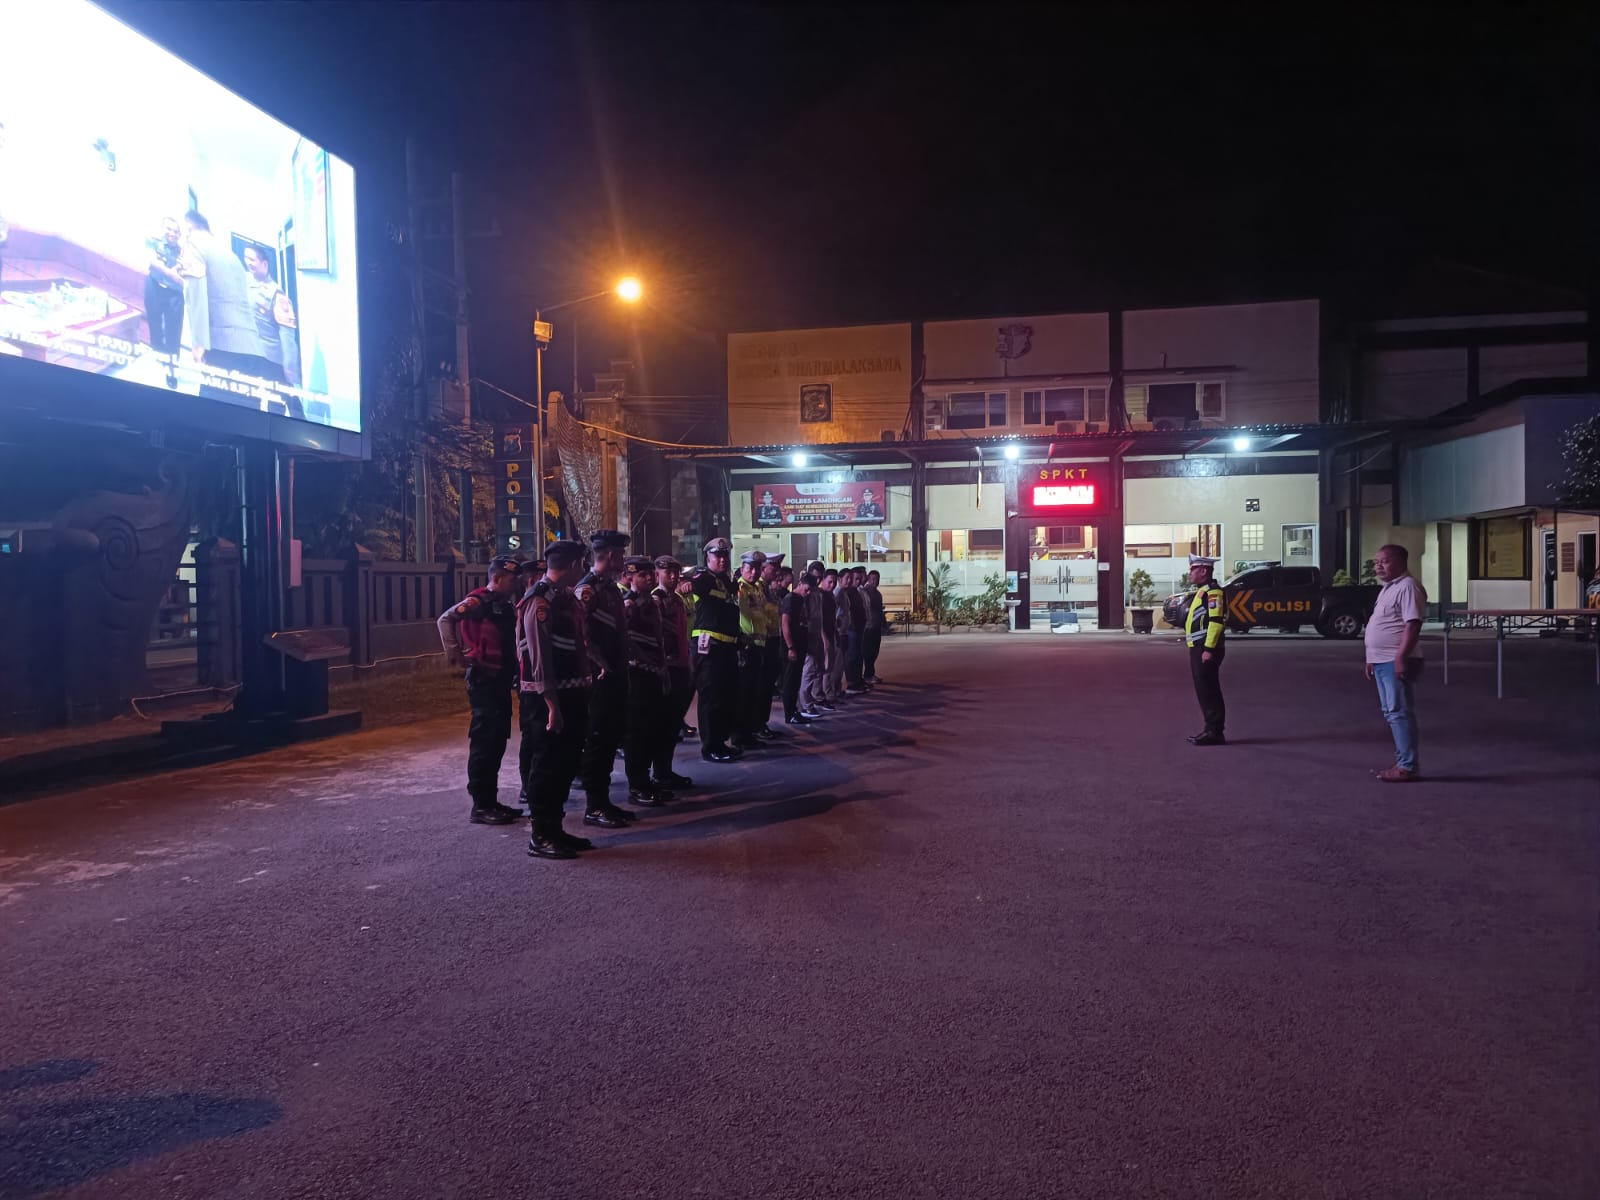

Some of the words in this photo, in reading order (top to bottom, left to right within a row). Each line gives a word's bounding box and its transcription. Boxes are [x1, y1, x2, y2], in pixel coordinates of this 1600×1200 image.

[1040, 468, 1088, 480] SPKT
[506, 462, 521, 550] POLIS
[1253, 600, 1311, 612] POLISI
